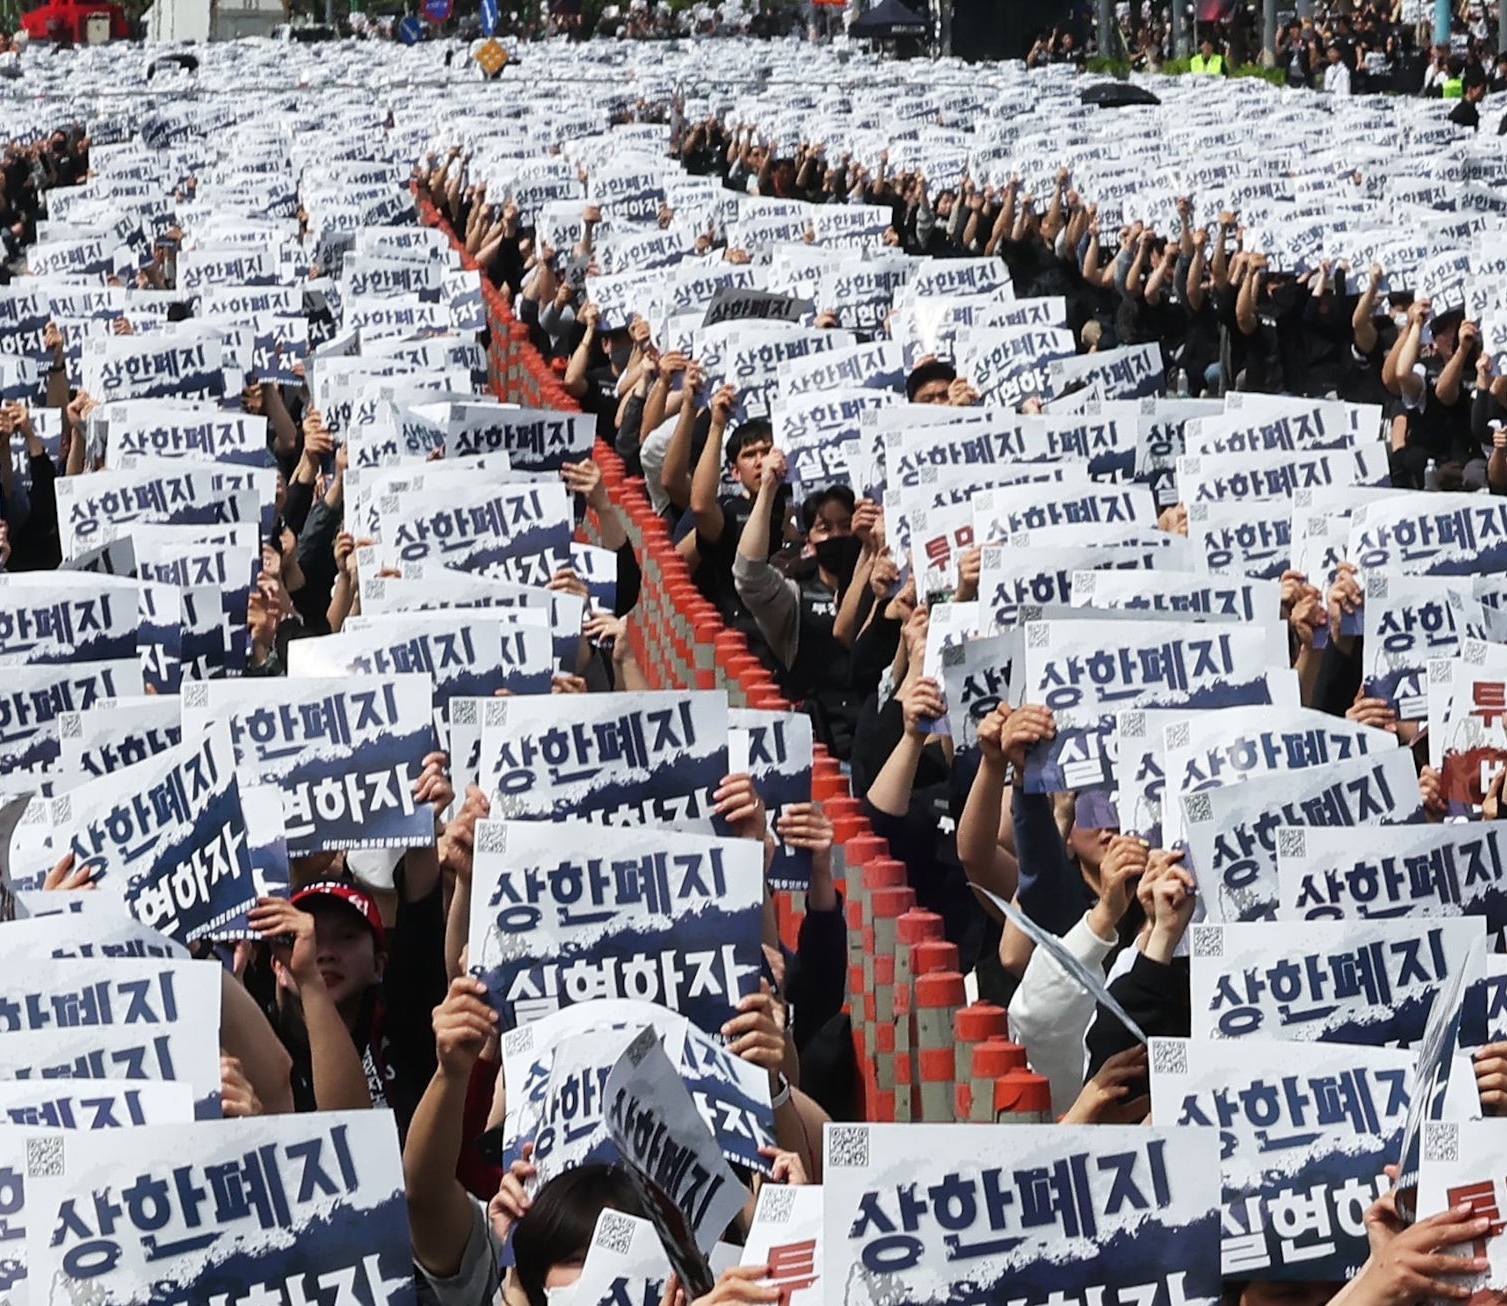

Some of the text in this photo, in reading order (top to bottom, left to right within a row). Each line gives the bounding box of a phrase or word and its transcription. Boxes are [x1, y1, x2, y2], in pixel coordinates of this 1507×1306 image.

[183, 255, 263, 286] 상한폐지
[349, 267, 432, 295] 상한폐지
[916, 262, 997, 295] 상한폐지
[100, 345, 205, 390] 상한폐지
[788, 347, 885, 396] 상한폐지
[974, 330, 1059, 383] 상한폐지
[119, 420, 246, 458] 상한폐지
[455, 418, 575, 453] 상한폐지
[897, 427, 1024, 486] 상한폐지
[70, 474, 196, 536] 상한폐지
[396, 490, 545, 561] 상한폐지
[1377, 601, 1457, 653] 상한
[1039, 634, 1233, 709] 상한폐지
[493, 701, 695, 794] 상한폐지
[71, 737, 218, 880] 상한폐지
[283, 762, 416, 832] 현하자
[136, 824, 246, 938] 현하자
[489, 848, 727, 933] 상한폐지
[1296, 832, 1503, 920] 상한폐지
[506, 944, 761, 1028] 실현하자
[1210, 929, 1447, 1036] 상한폐지
[50, 1124, 356, 1279] 상한폐지
[849, 1140, 1169, 1274] 상한폐지
